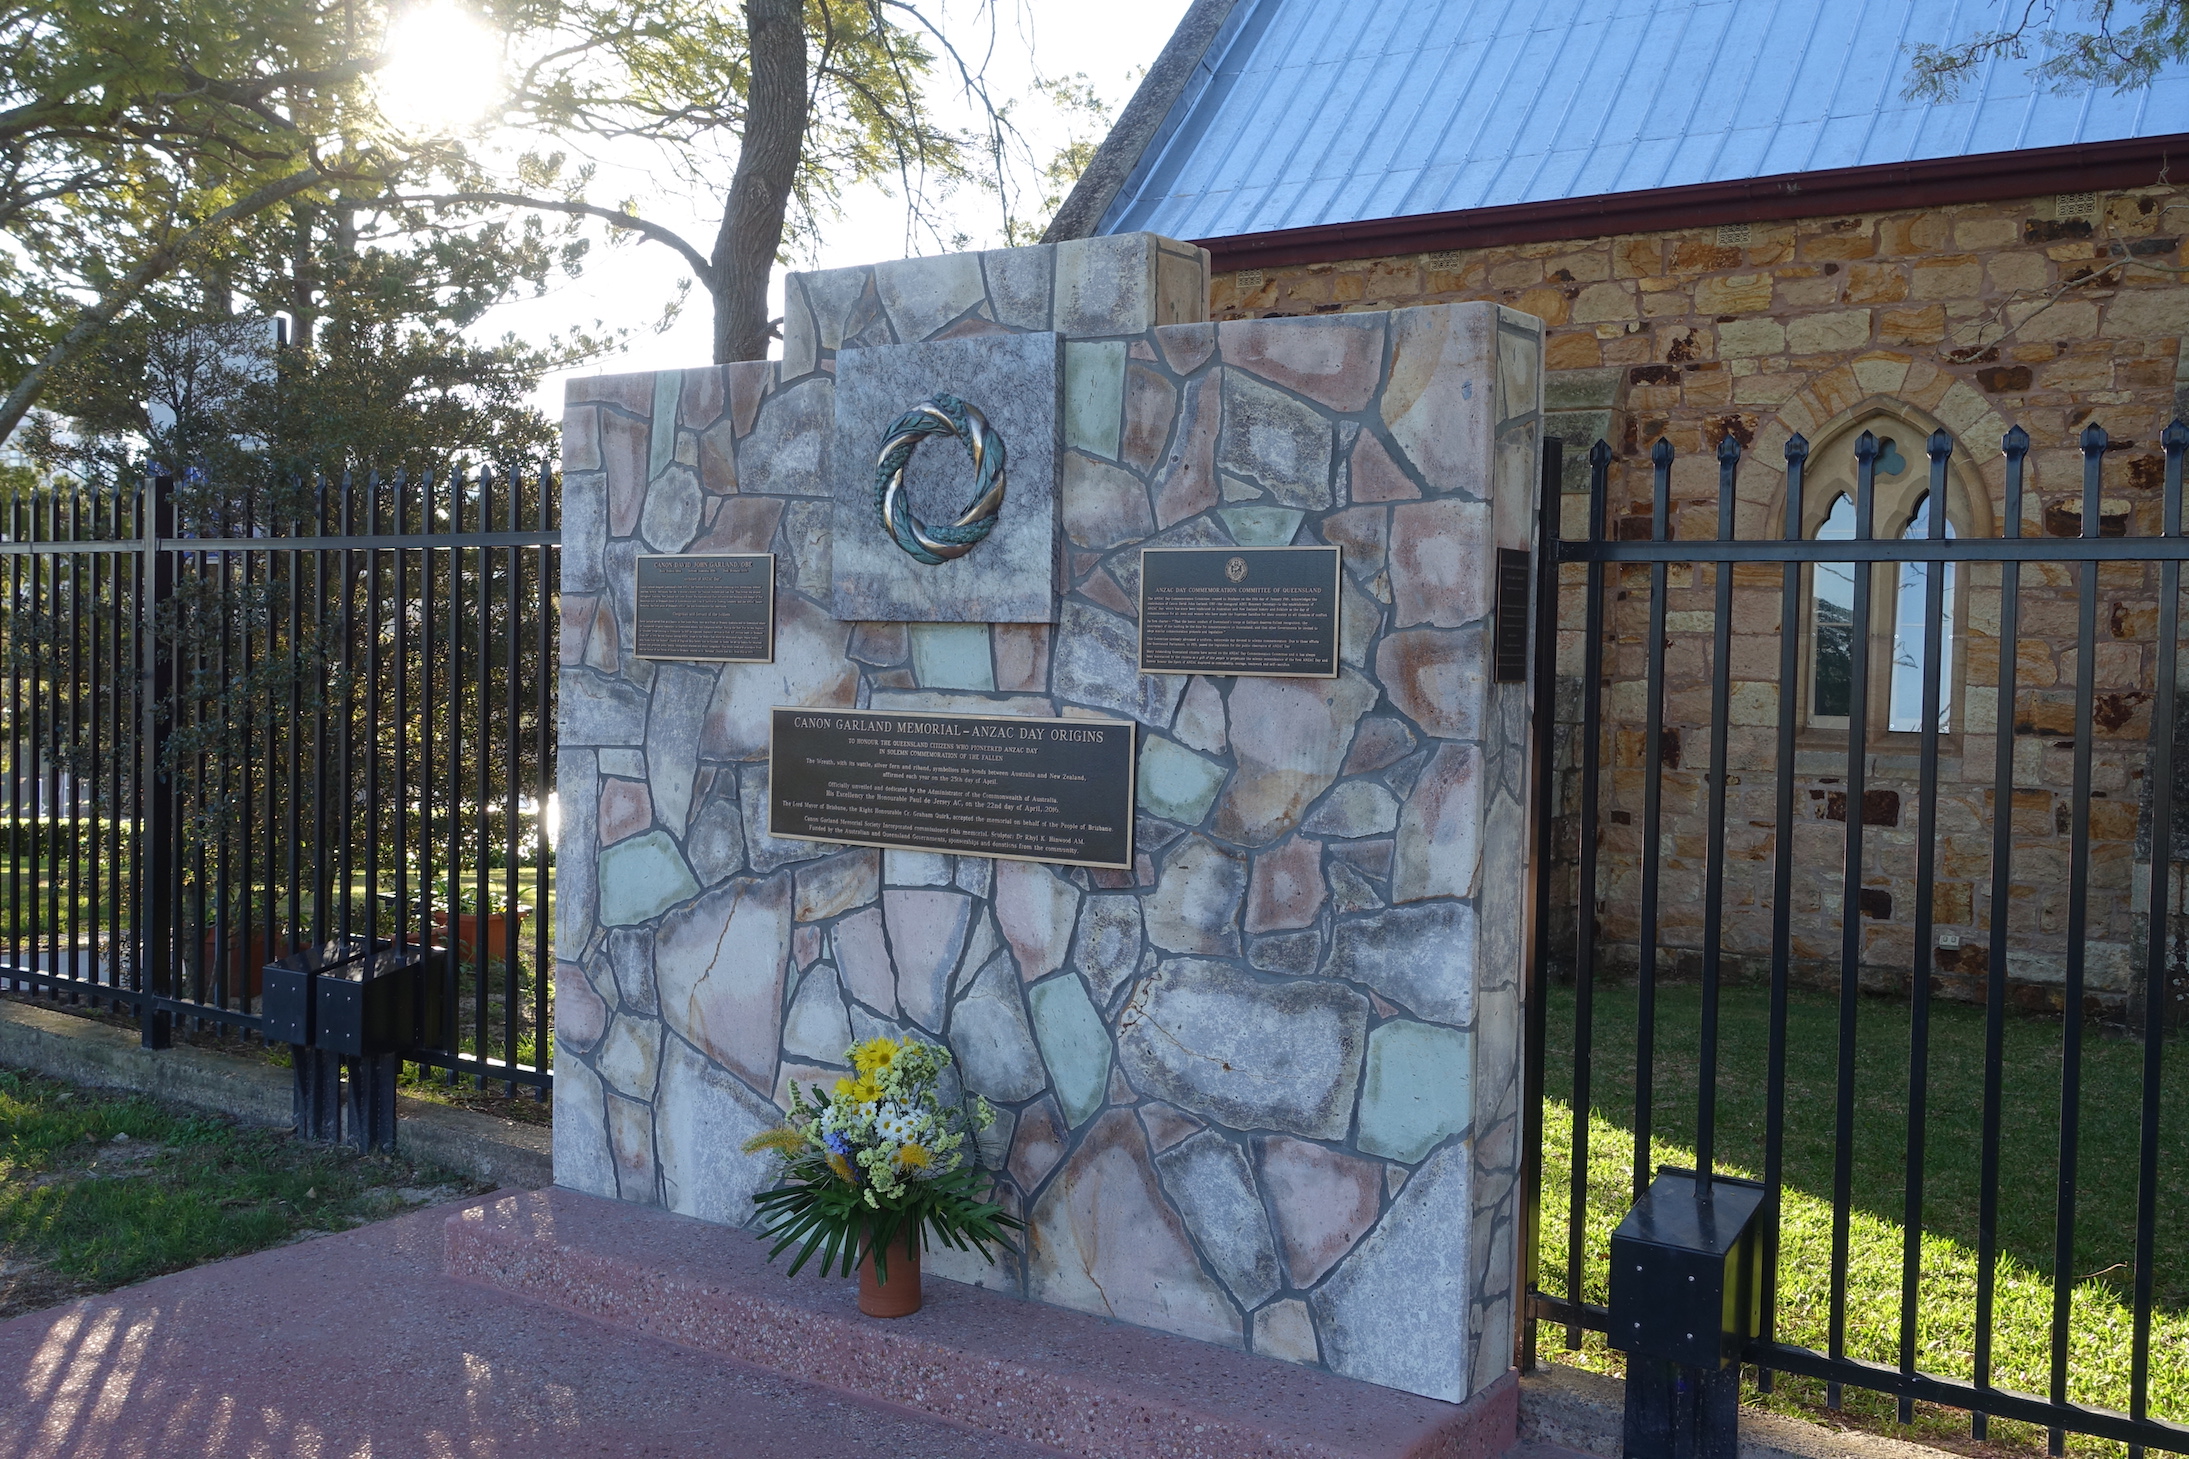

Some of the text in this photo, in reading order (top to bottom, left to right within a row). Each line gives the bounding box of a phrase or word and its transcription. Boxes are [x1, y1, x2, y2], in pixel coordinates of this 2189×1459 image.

[794, 717, 831, 729] CANON
[836, 719, 892, 732] GARLAND
[1020, 727, 1044, 740] DAY
[1051, 729, 1103, 742] ORIGINS
[910, 750, 958, 759] COMMEMORATION
[1063, 774, 1086, 782] Zealand,
[836, 791, 864, 800] Excellency
[933, 798, 951, 807] Jersey
[1025, 805, 1042, 814] April,
[826, 804, 848, 812] Brisbane,
[935, 812, 951, 820] Quirk,
[953, 814, 974, 822] accepted
[1061, 822, 1078, 831] People
[865, 821, 881, 829] Society
[883, 822, 912, 832] Incorporated
[914, 825, 948, 833] commissioned
[912, 834, 947, 844] Governments,
[948, 837, 979, 847] sponsorships
[1045, 845, 1079, 856] community.
